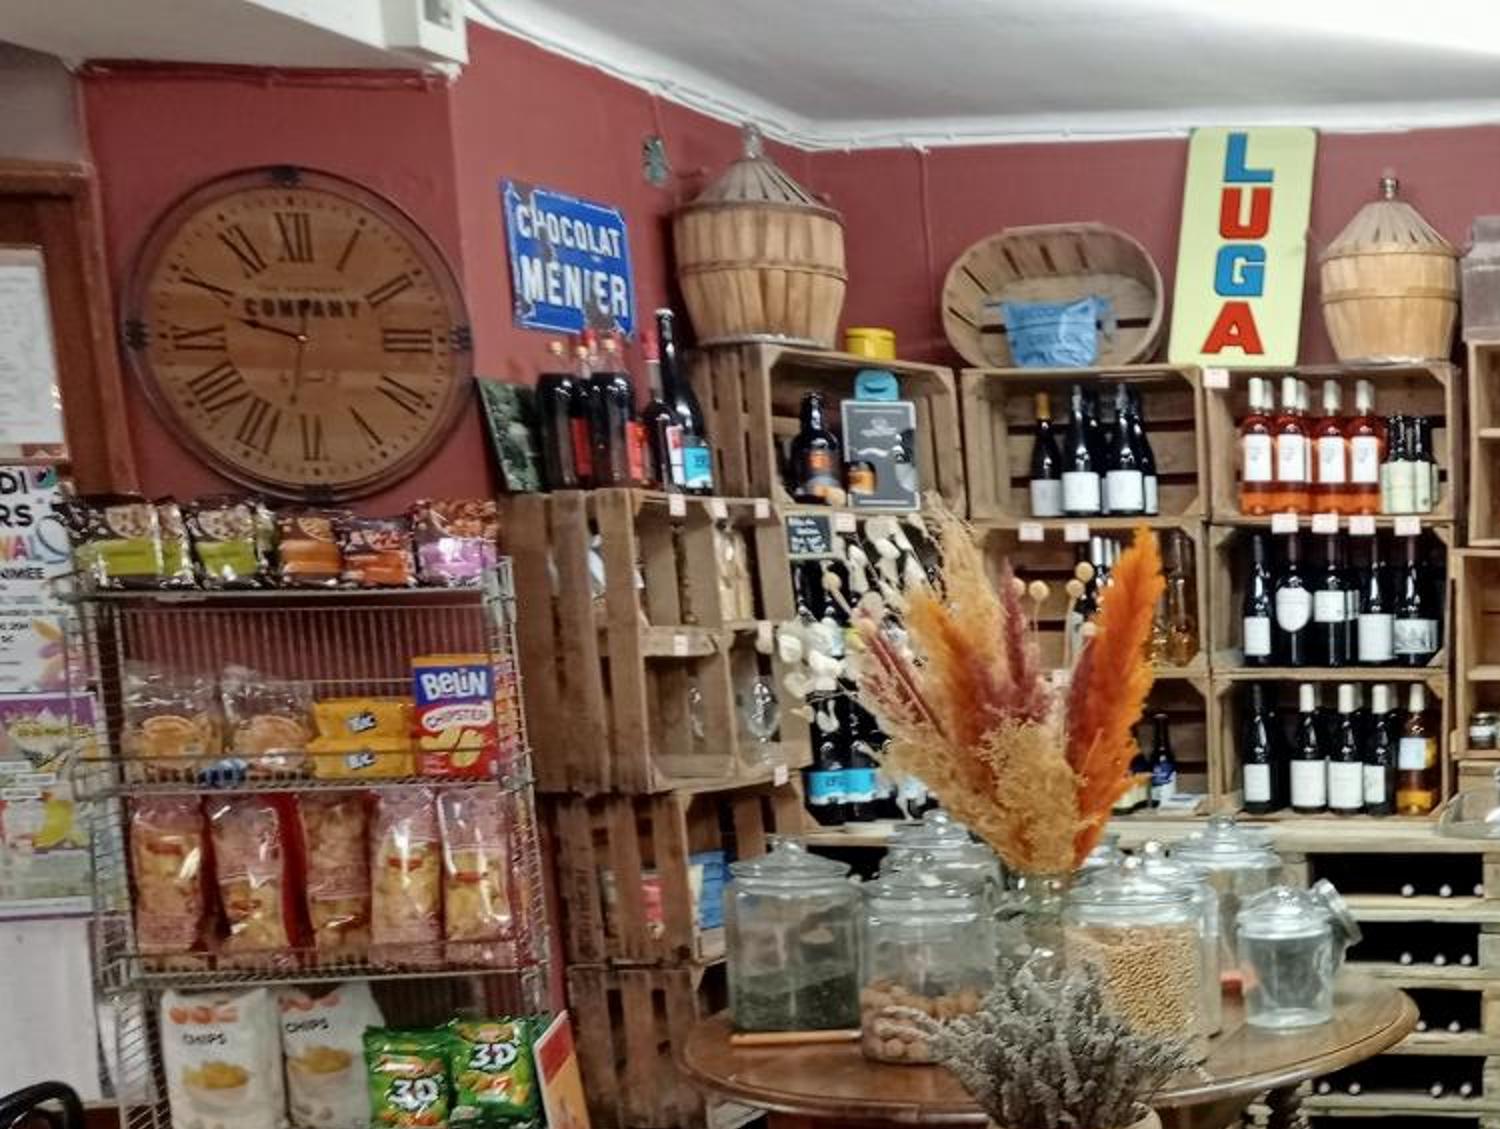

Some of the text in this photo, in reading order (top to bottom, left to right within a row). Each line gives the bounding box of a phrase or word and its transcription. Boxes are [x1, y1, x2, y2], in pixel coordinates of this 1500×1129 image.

[516, 203, 622, 259] CHOCOLAT
[1200, 133, 1274, 355] LUGA
[245, 298, 360, 318] COMPANY
[520, 255, 628, 319] MENIER
[383, 328, 432, 352] III
